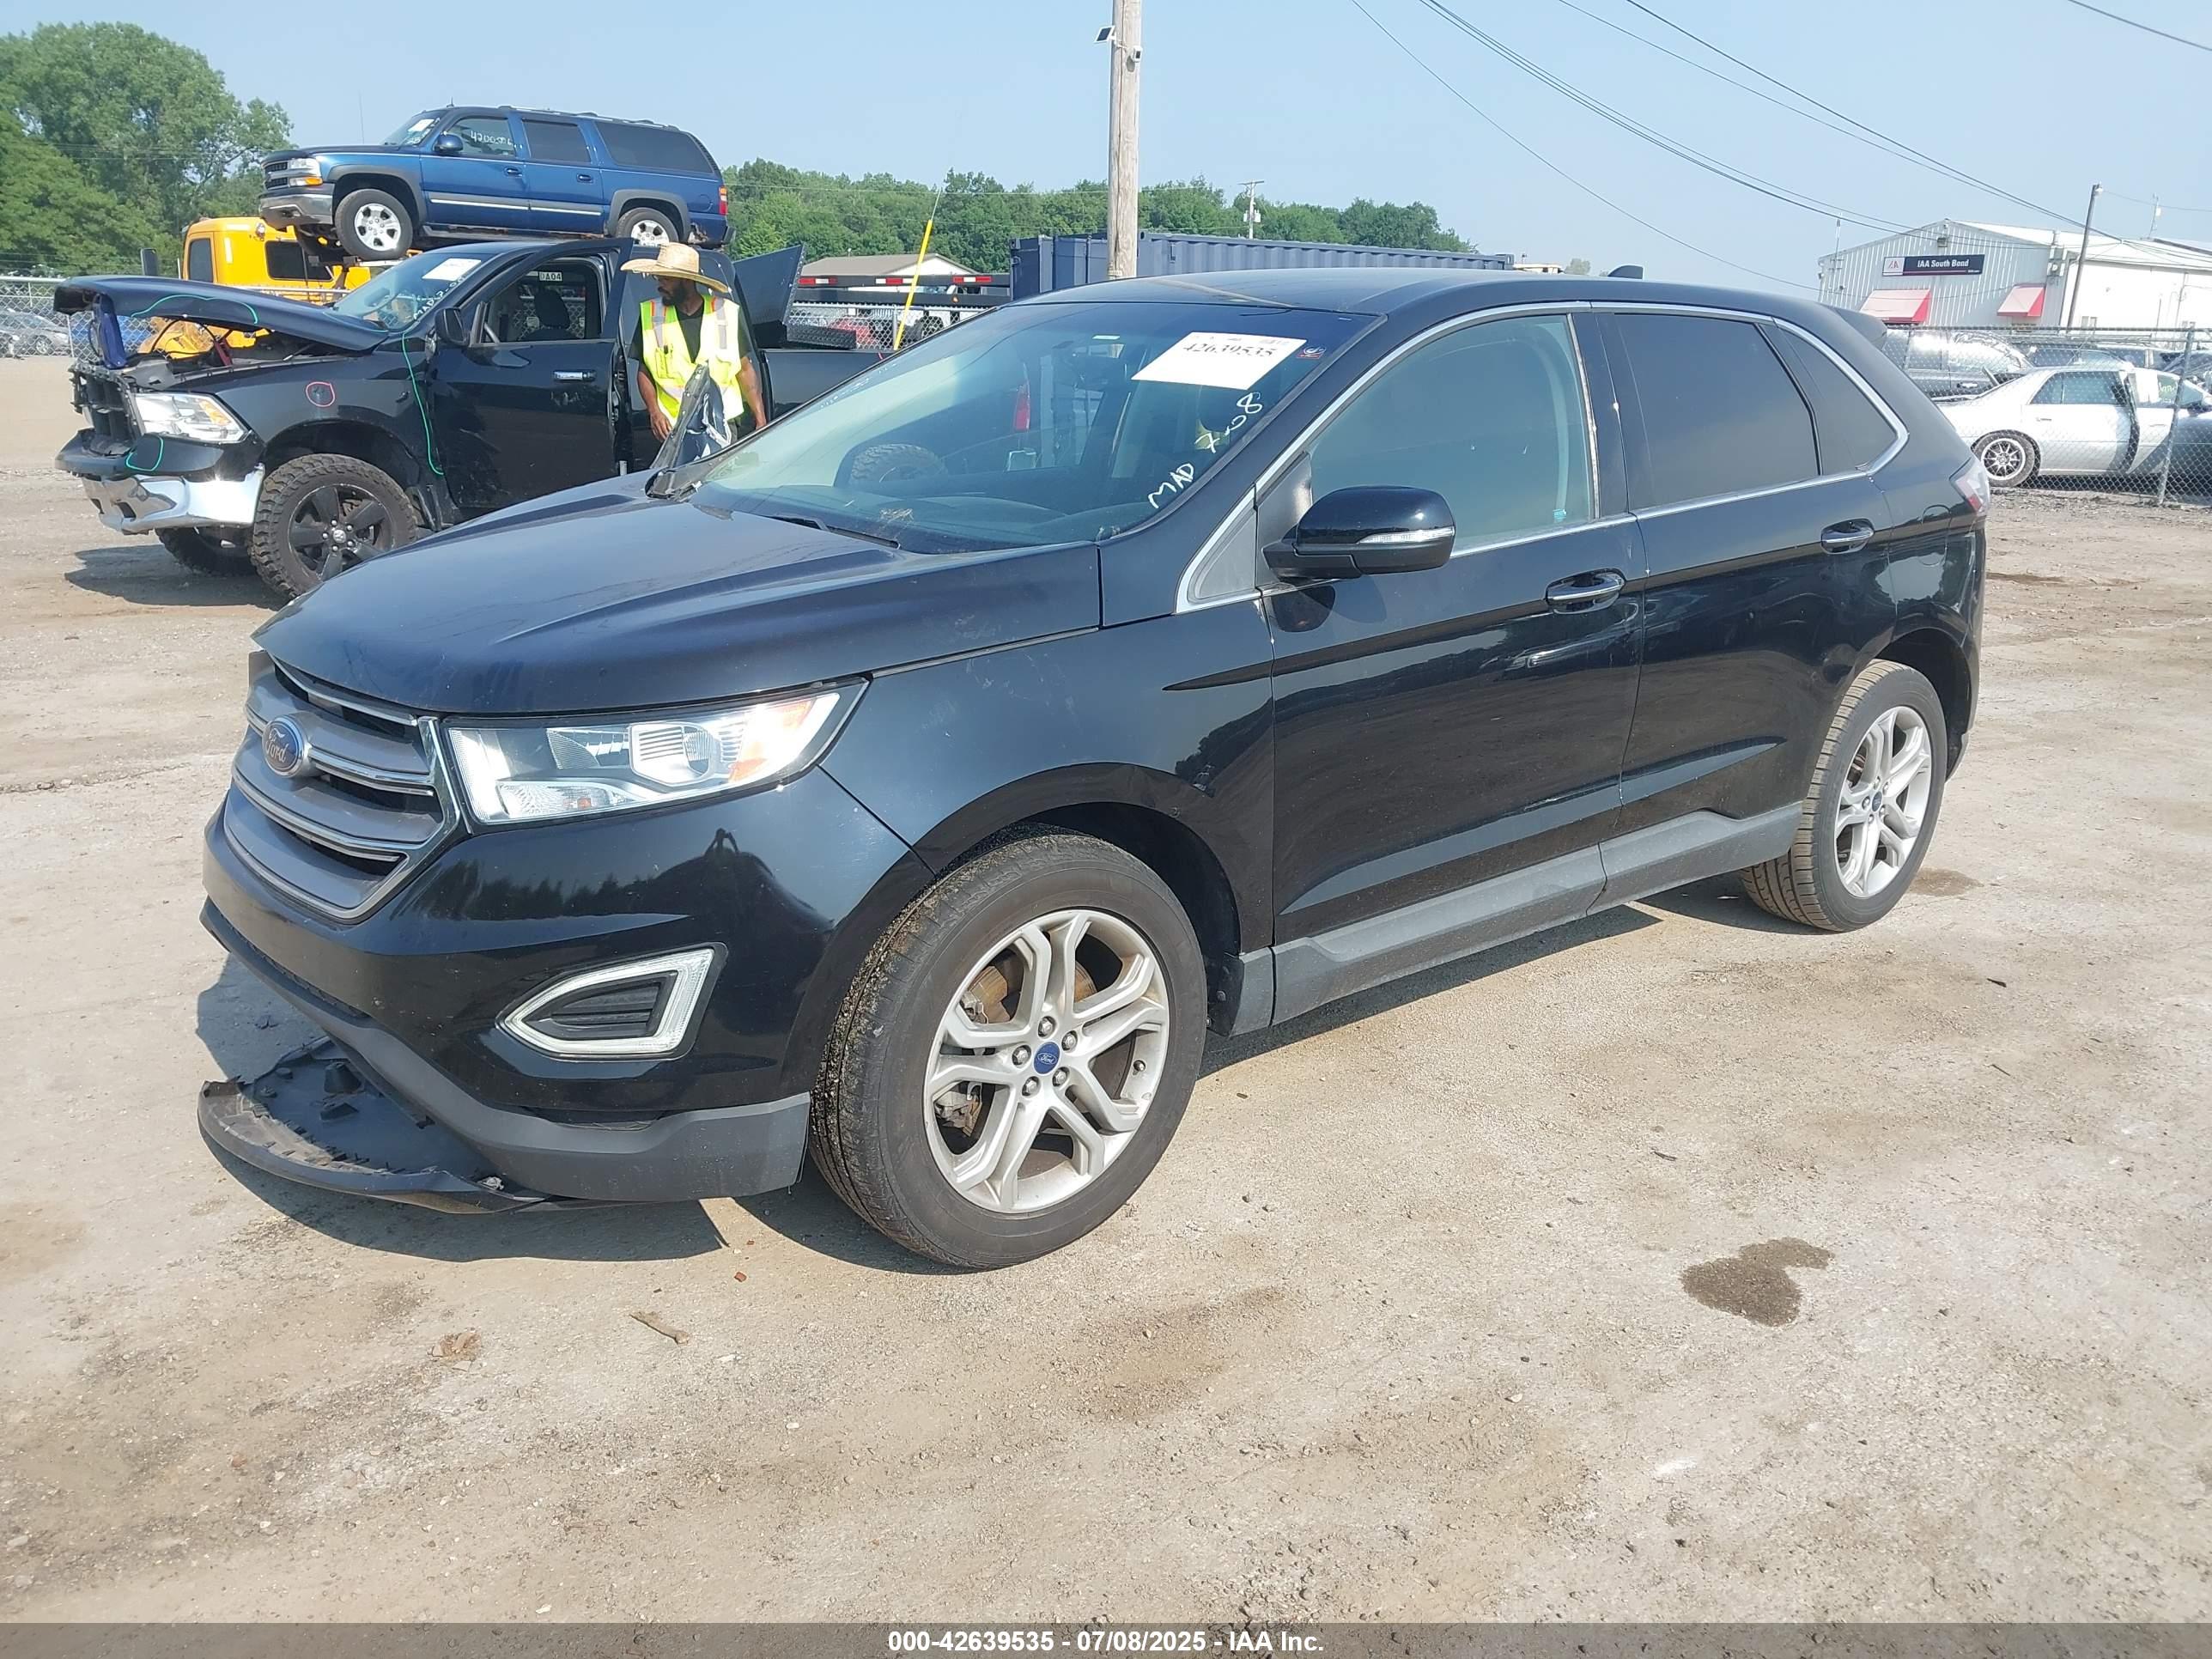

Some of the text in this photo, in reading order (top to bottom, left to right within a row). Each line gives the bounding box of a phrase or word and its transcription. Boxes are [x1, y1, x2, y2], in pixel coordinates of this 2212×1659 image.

[1930, 259, 1950, 268] South
[1183, 343, 1278, 357] 42639535
[1148, 463, 1194, 509] MAD
[265, 727, 289, 763] Ford
